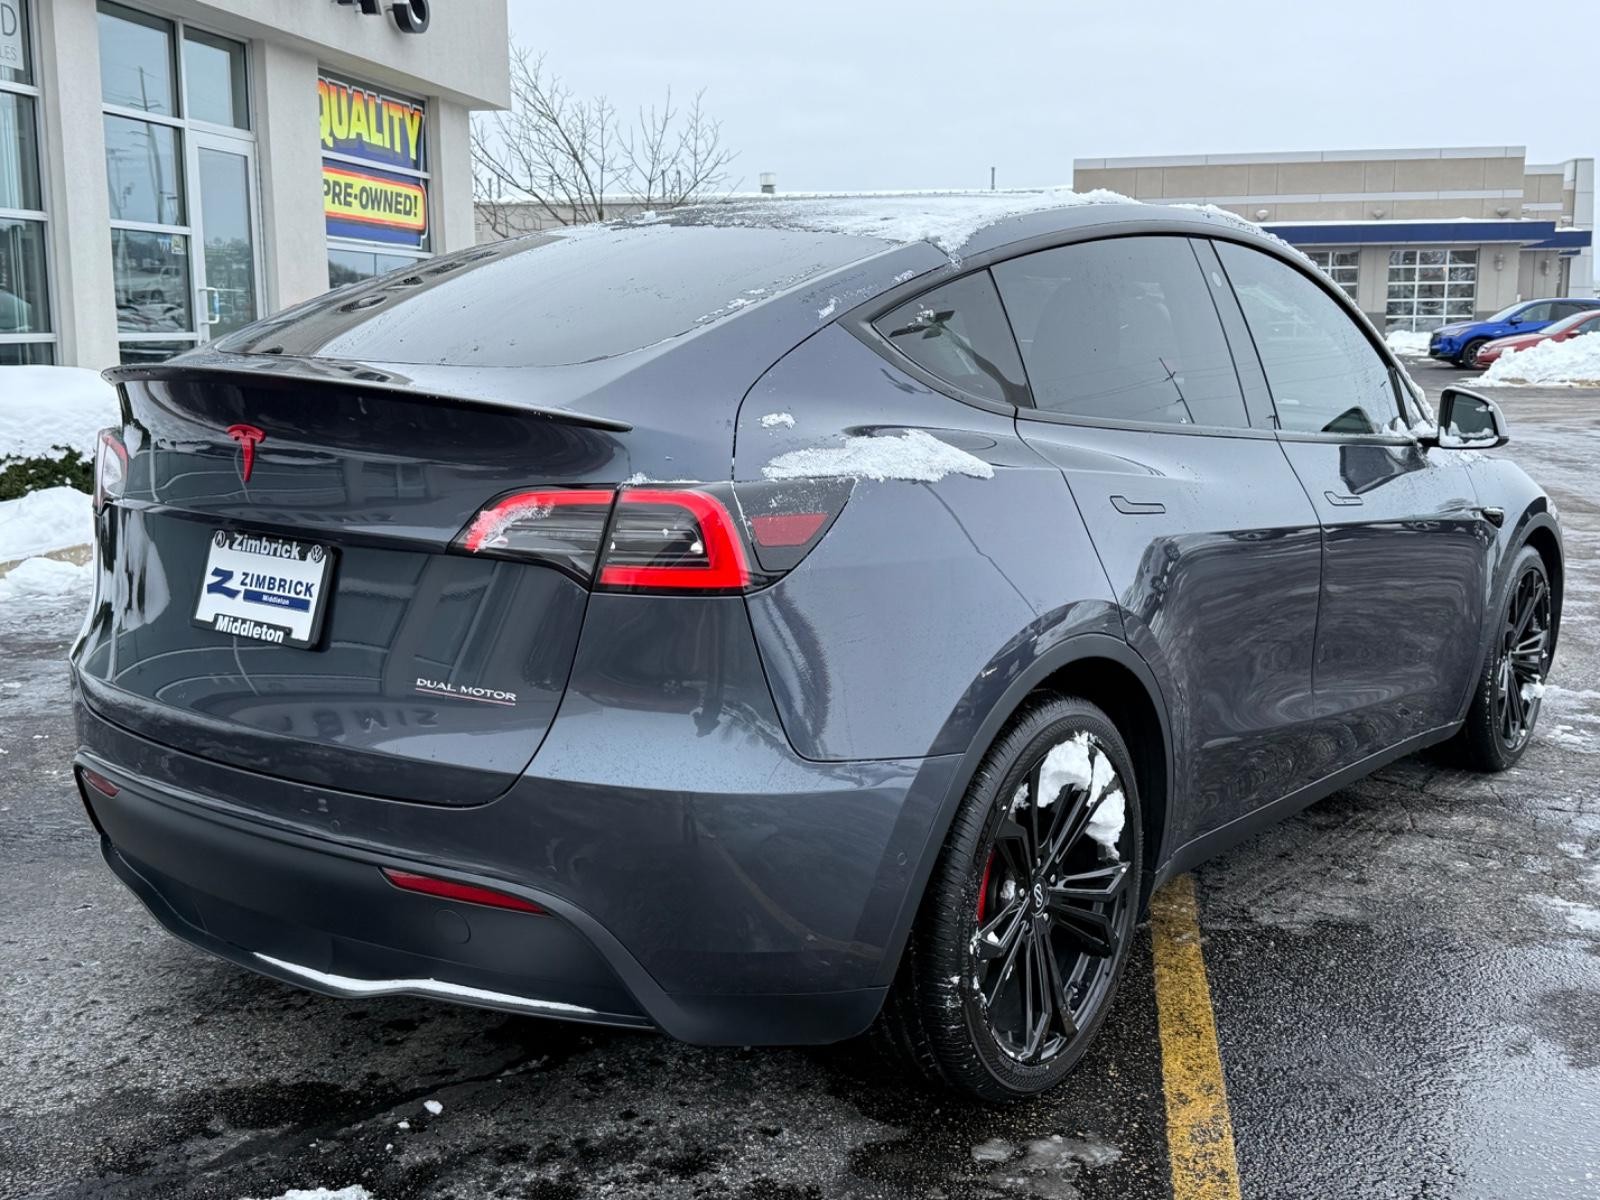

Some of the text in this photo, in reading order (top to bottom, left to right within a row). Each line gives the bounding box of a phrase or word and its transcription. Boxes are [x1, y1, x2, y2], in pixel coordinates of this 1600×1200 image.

[318, 79, 421, 160] QUALITY
[232, 533, 301, 560] Zimbrick
[240, 572, 315, 598] ZIMBRICK
[262, 595, 290, 606] Middleton
[215, 615, 284, 643] Middleton
[416, 677, 517, 701] DUAL MOTOR
